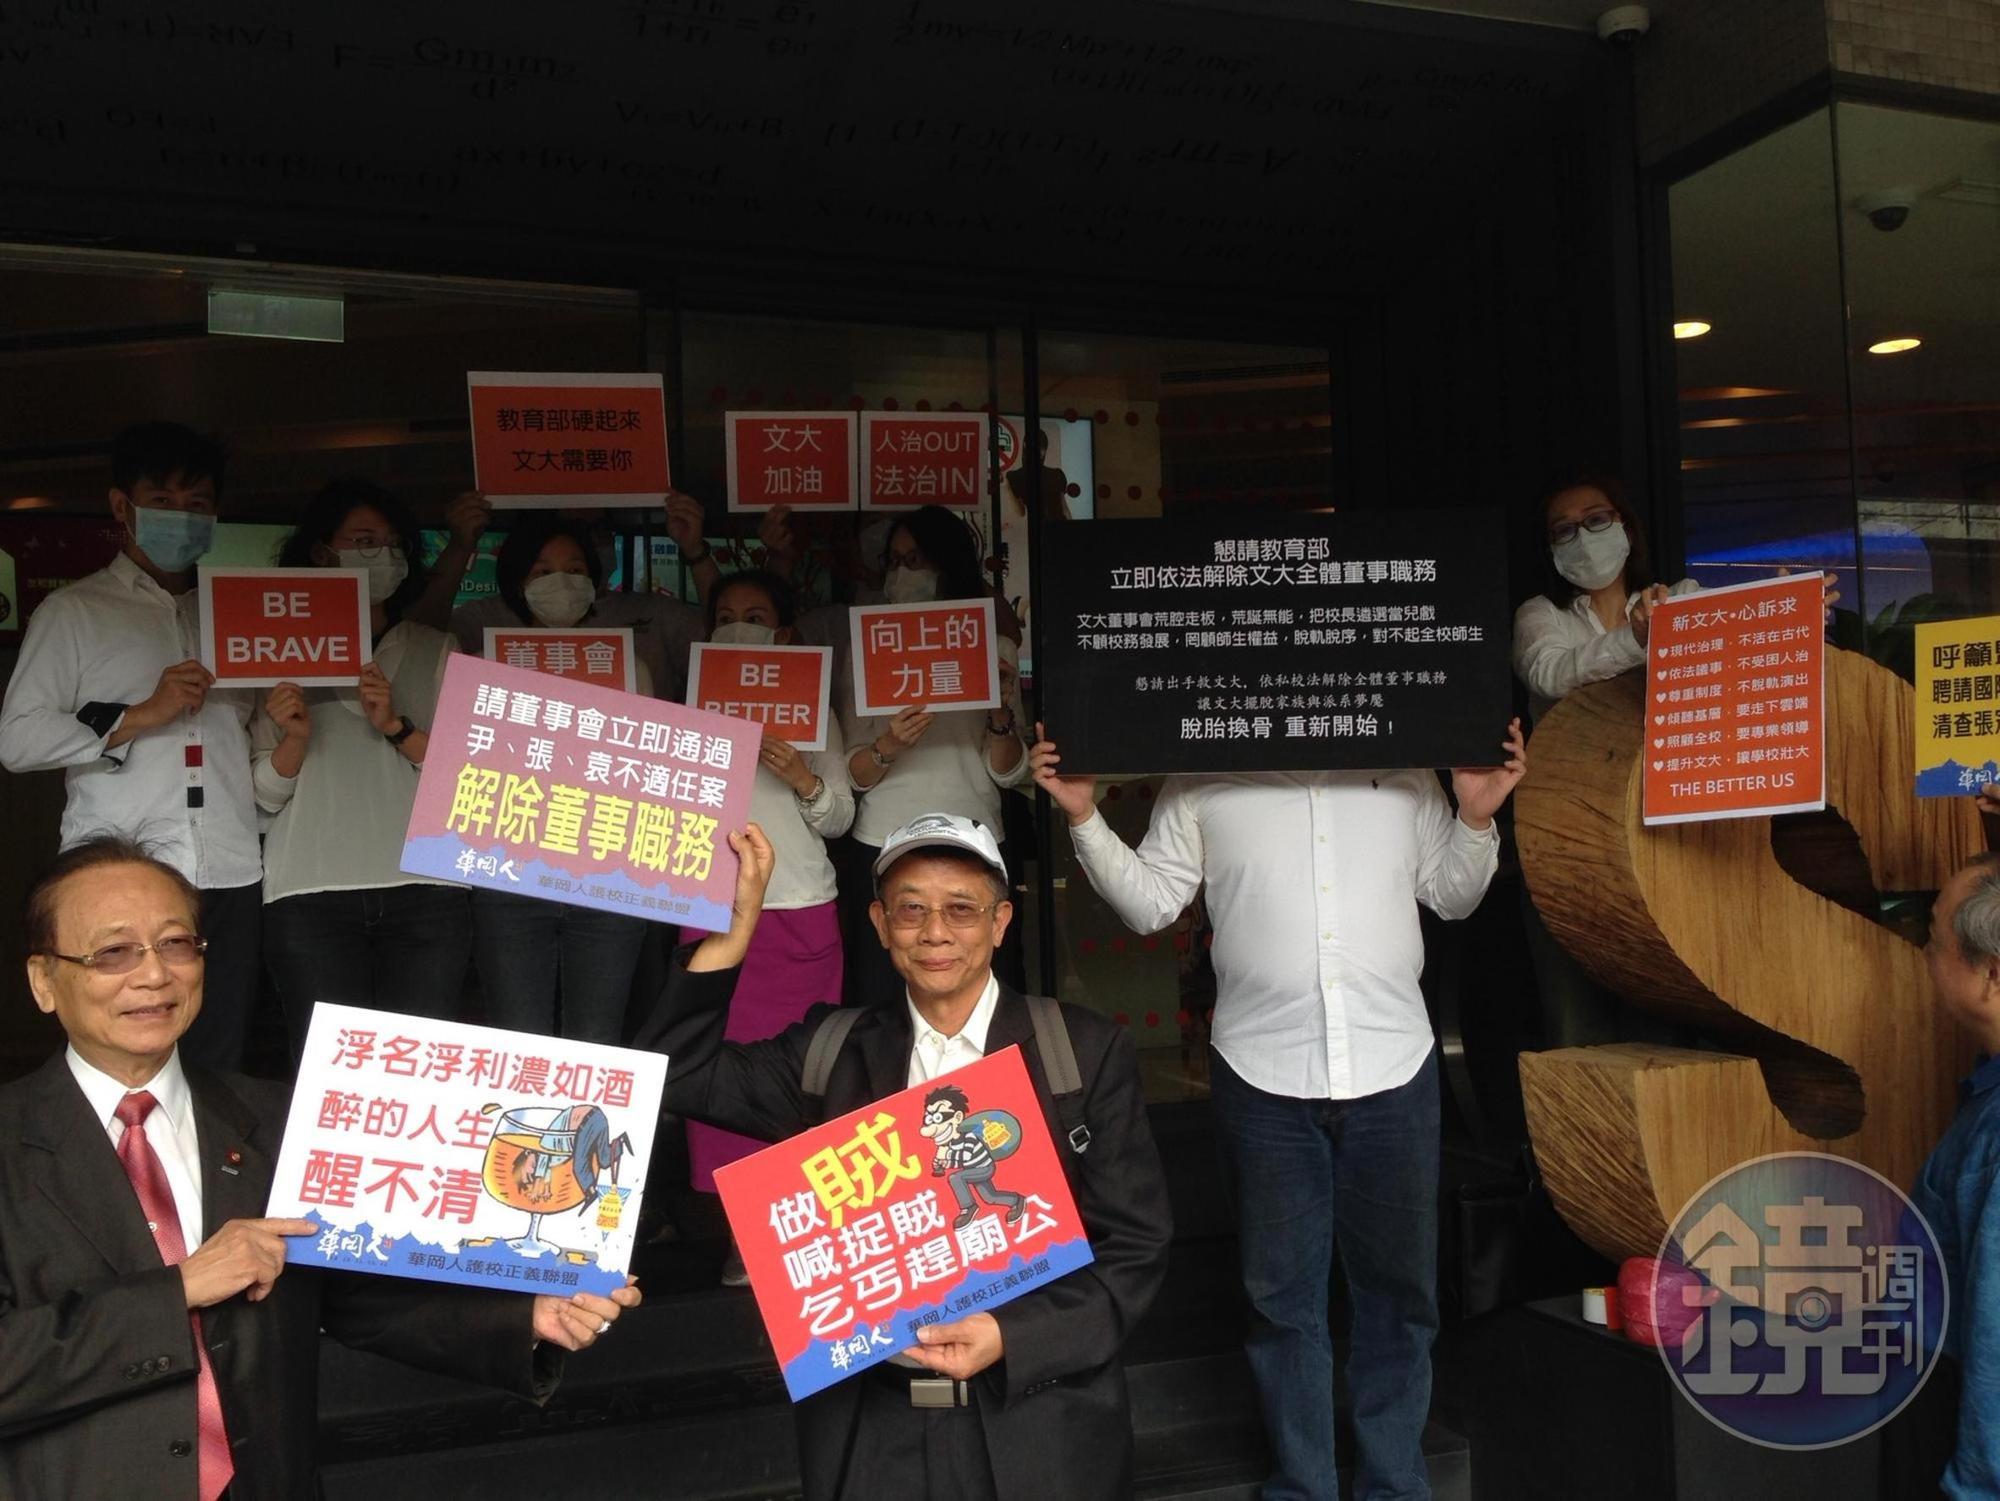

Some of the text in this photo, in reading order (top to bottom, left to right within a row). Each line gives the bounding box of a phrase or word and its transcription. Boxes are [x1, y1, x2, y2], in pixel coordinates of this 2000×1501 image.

[496, 408, 642, 432] 教育部硬起來
[762, 424, 822, 454] 文大
[875, 430, 976, 454] 人治OUT
[512, 448, 633, 473] 文大需要你
[763, 464, 824, 496] 加油
[875, 464, 975, 497] 法治IN
[1214, 537, 1331, 563] 懇請教育部
[1110, 559, 1437, 590] 立即依法解除文大全體董事職務
[262, 590, 312, 619] BE
[226, 635, 350, 664] BRAVE
[869, 616, 979, 654] 向上的
[504, 640, 616, 675] 董事會
[1933, 639, 2000, 670] 呼籲
[740, 663, 781, 688] BE
[892, 661, 964, 699] 力量
[473, 683, 733, 770] 請董事會立即通過
[1180, 716, 1273, 740] 脫胎換骨
[467, 723, 728, 809] 尹、張、袁不適任案
[1670, 773, 1795, 797] THE BETTER US
[446, 762, 719, 881] 解除董事職務
[331, 1027, 635, 1108] 浮名浮利濃如酒
[317, 1089, 494, 1151] 醉的人生
[298, 1148, 484, 1225] 醒不清
[782, 1188, 946, 1290] 喊捉賊
[407, 1251, 580, 1286] 華岡人護校正義聯盟
[799, 1194, 1058, 1336] 乞丐趕廟公
